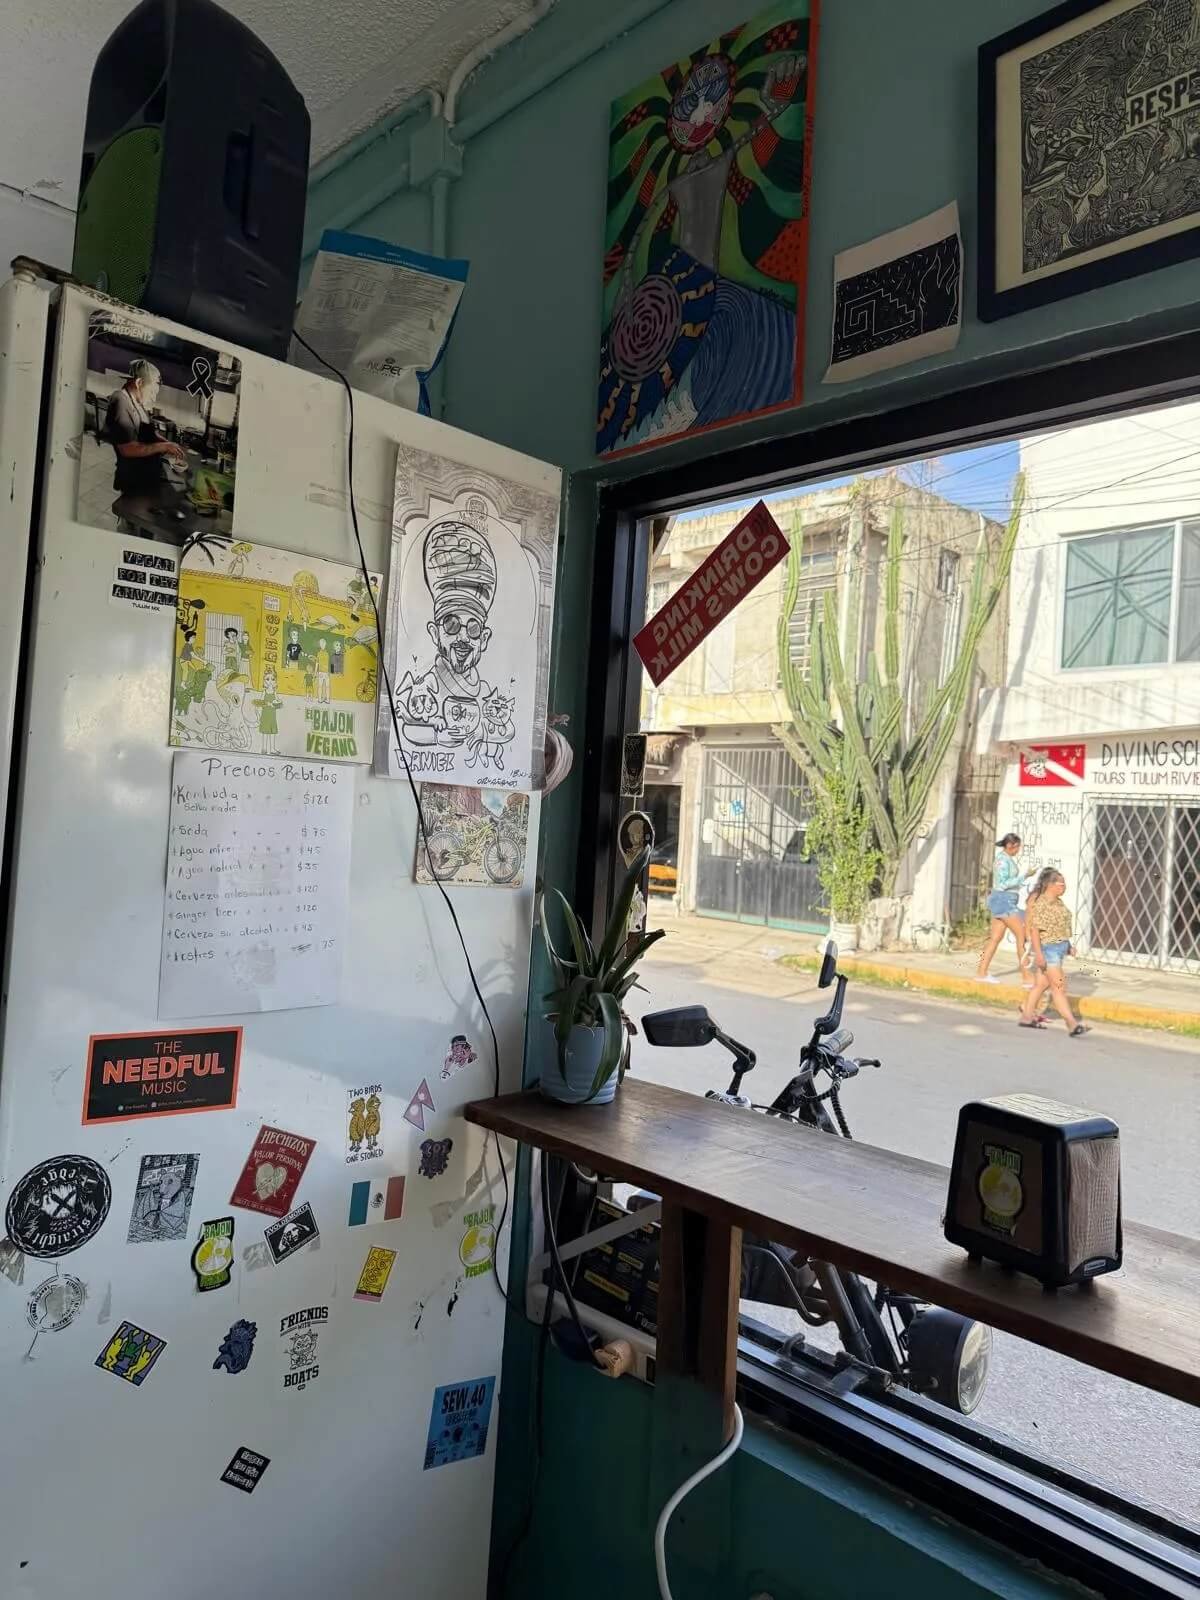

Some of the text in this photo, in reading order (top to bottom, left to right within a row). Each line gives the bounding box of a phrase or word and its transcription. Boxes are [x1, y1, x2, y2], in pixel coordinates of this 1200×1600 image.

[123, 550, 175, 573] VEGAN
[118, 567, 178, 590] FOR THE
[314, 709, 353, 734] BAJON
[306, 733, 358, 757] VEGANO
[1102, 740, 1168, 767] DIVING
[200, 758, 337, 784] Precios Bebidas
[1093, 771, 1125, 785] TOURS
[1131, 771, 1168, 785] TULUM
[154, 1041, 182, 1054] THE
[102, 1052, 225, 1084] NEEDFUL
[141, 1080, 187, 1096] MUSIC
[347, 1084, 382, 1098] TWO BIRDS
[260, 1130, 310, 1157] HECHIZOS
[346, 1148, 384, 1164] ONE STONED
[280, 1306, 328, 1332] FRIENDS
[284, 1365, 319, 1387] BOATS
